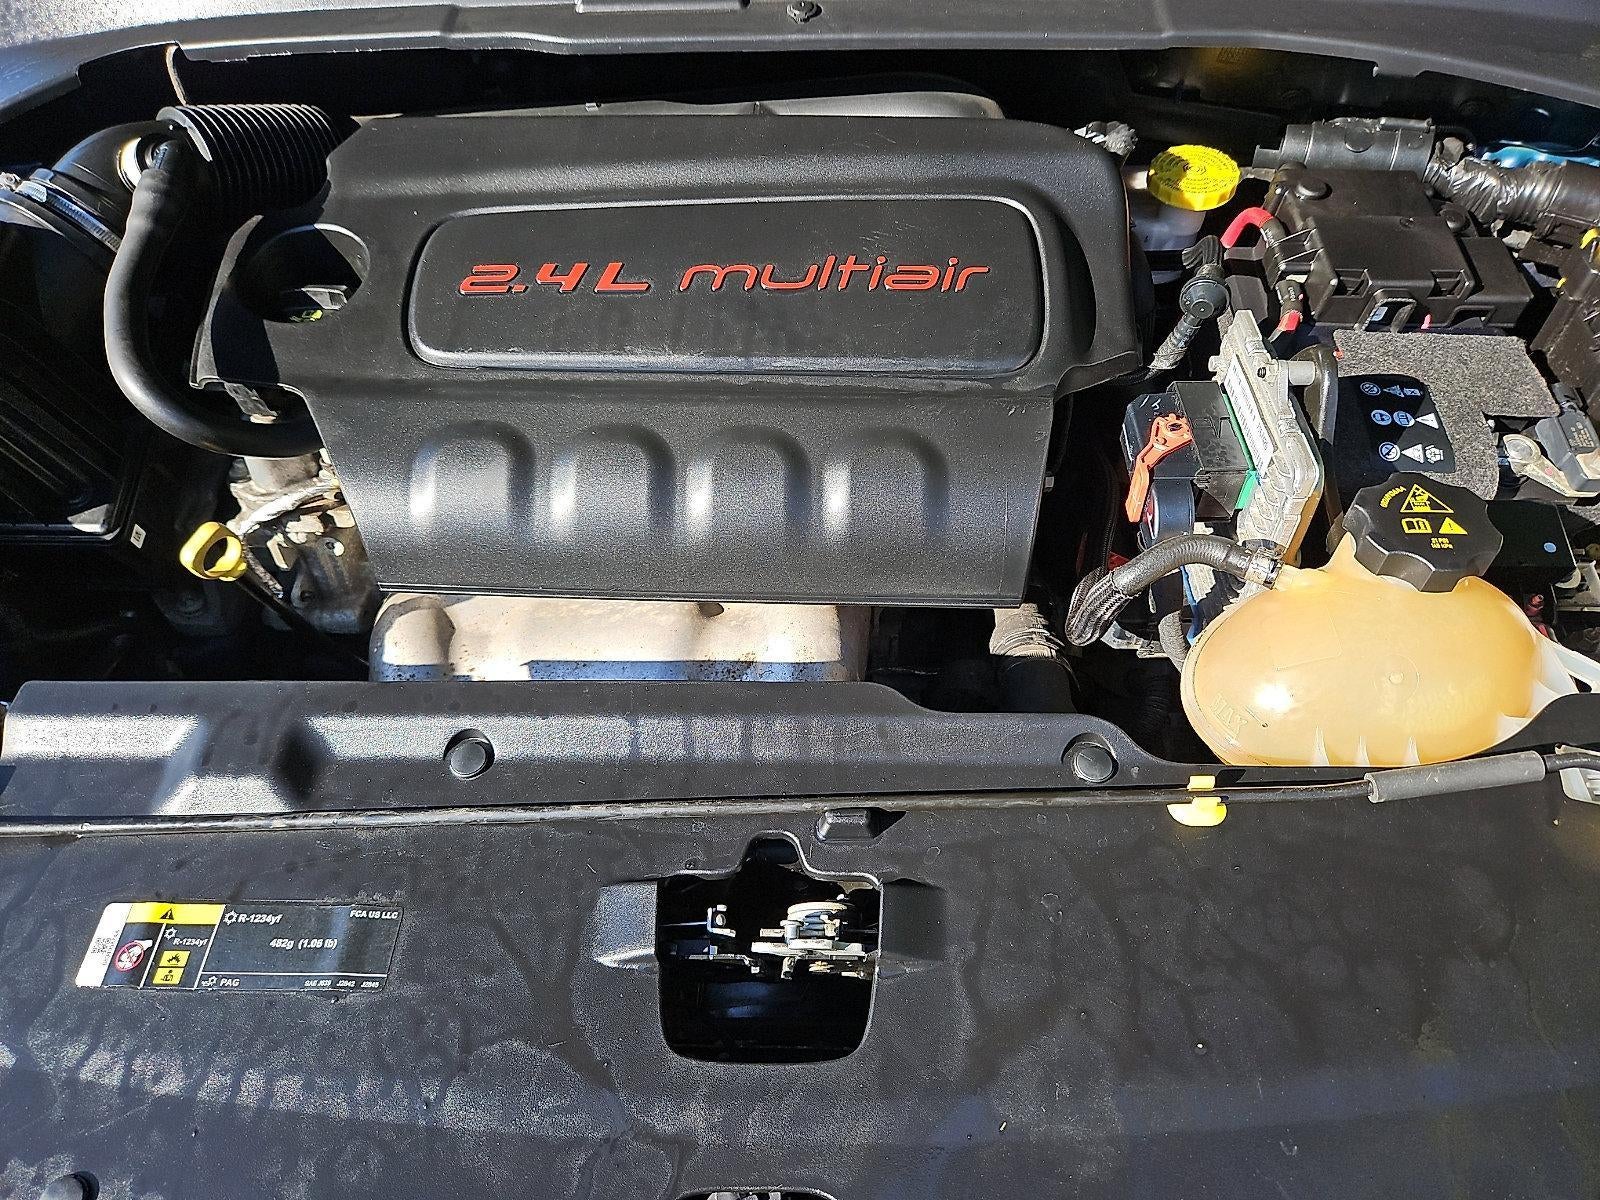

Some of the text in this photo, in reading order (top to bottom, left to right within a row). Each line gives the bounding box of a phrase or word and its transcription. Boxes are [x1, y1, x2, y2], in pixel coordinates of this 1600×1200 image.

[679, 254, 990, 293] multiair
[237, 913, 283, 926] R-1234yf
[350, 910, 399, 920] FCA US LLC
[172, 937, 209, 948] R-1234yf
[269, 938, 295, 950] 482g
[219, 978, 240, 987] PAG
